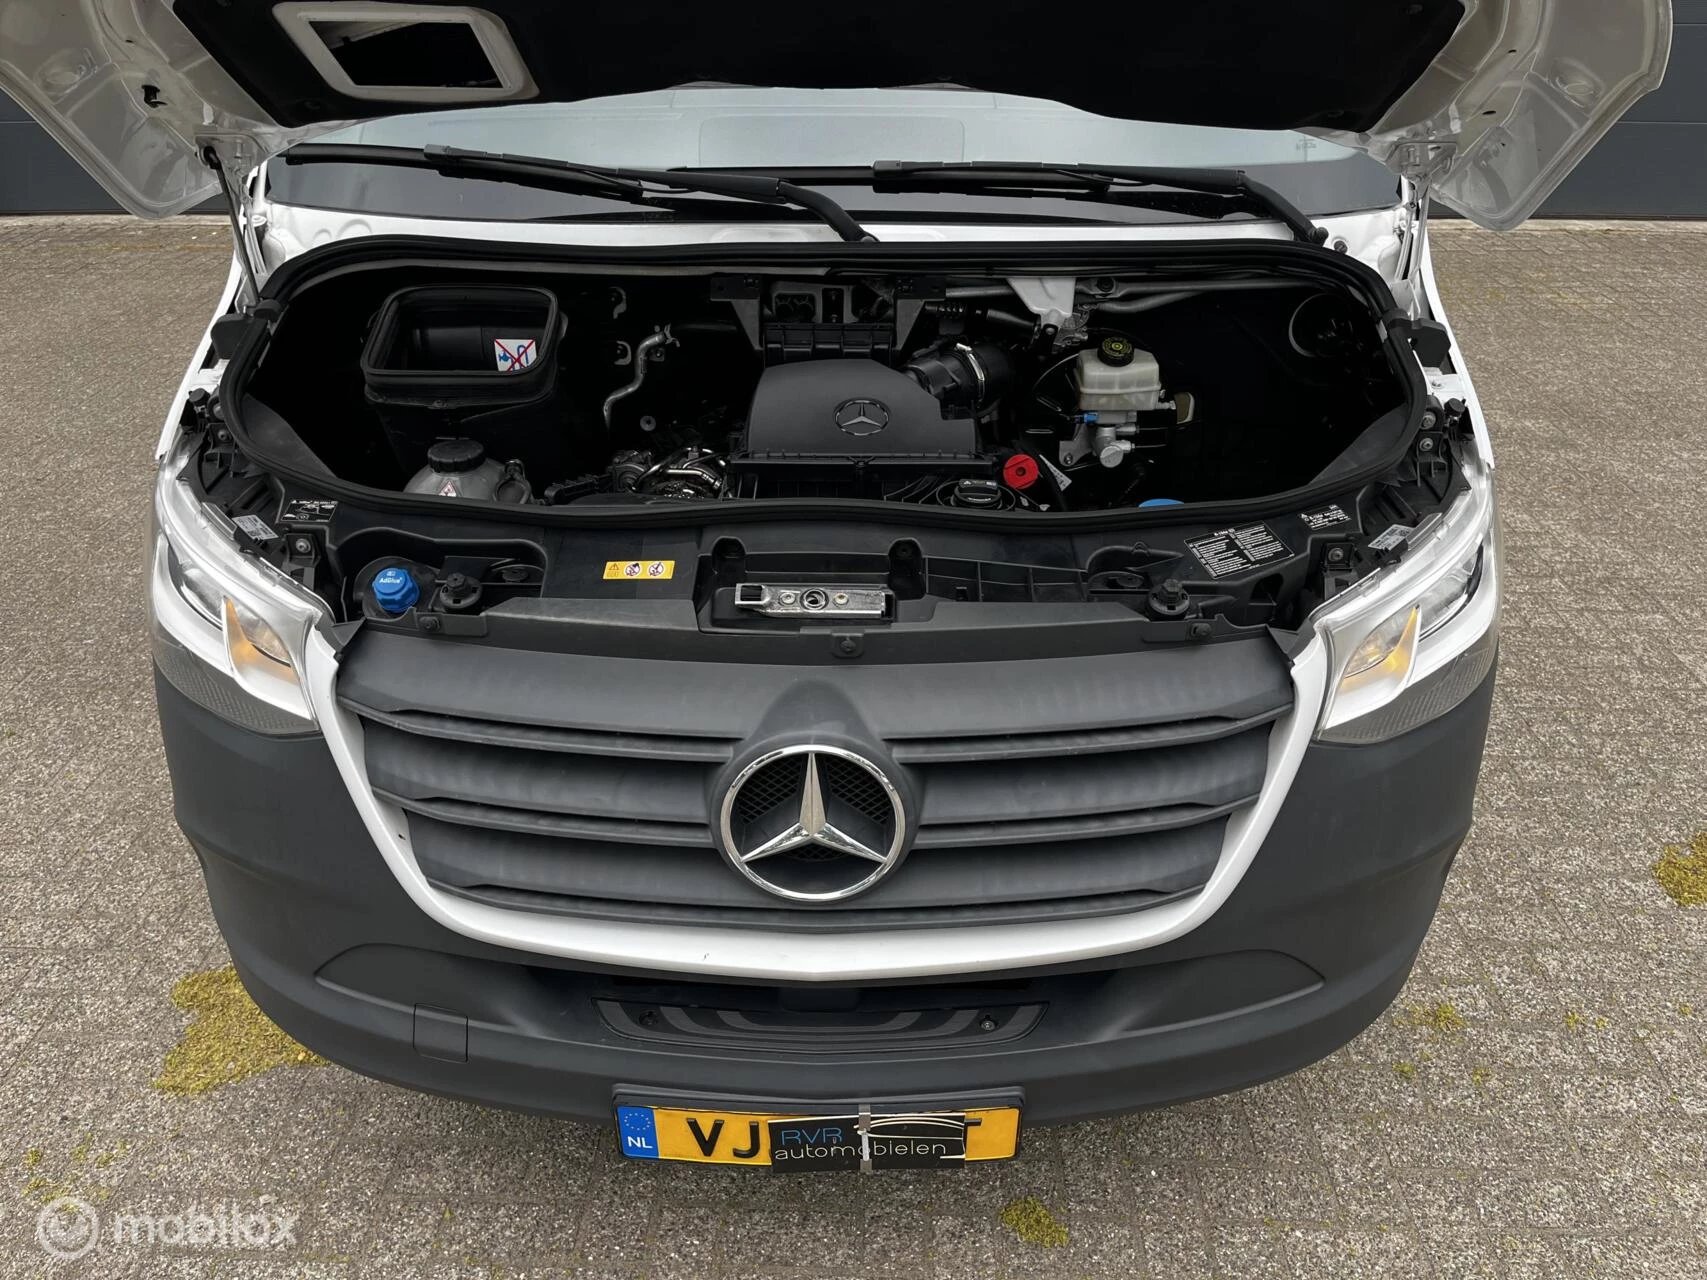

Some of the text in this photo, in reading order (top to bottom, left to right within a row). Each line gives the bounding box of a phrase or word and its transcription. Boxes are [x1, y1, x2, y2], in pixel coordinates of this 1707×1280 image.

[627, 1136, 653, 1149] NL
[686, 1117, 761, 1159] VJ
[781, 1127, 842, 1145] RVR
